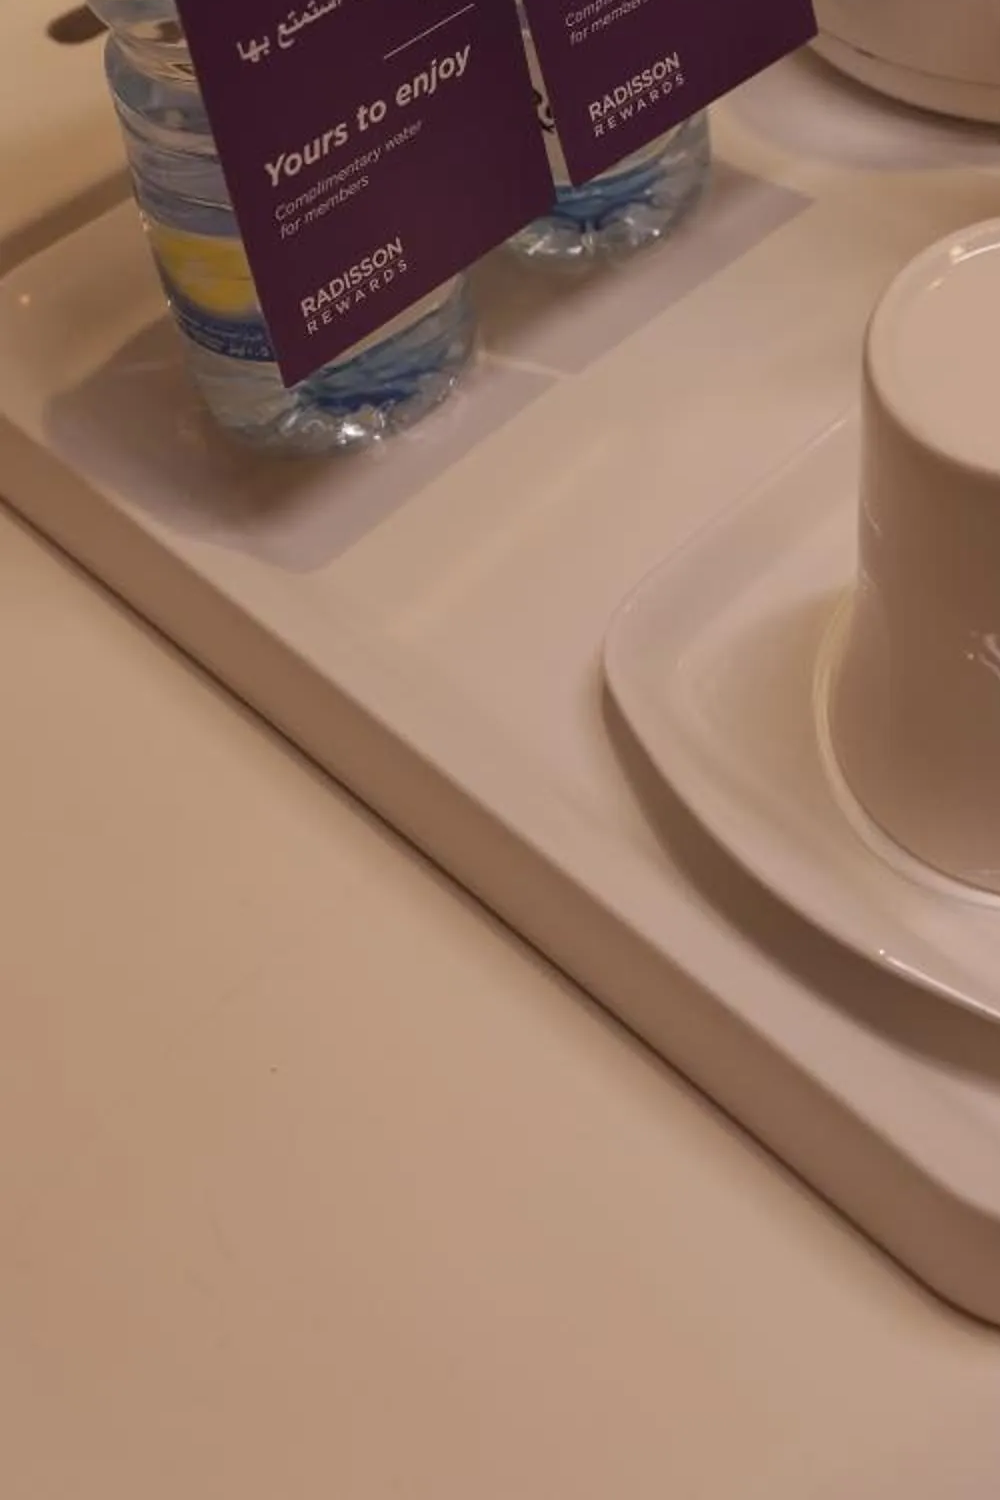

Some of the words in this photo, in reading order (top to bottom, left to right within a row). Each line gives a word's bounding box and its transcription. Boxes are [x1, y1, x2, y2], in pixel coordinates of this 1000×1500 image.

[236, 35, 271, 63] بها
[568, 25, 589, 46] for
[265, 121, 349, 187] Yours
[356, 99, 387, 130] to
[395, 44, 471, 105] enjoy
[588, 51, 681, 121] RADISSON
[594, 73, 685, 137] REWARDS
[274, 146, 382, 222] Complimentary
[384, 120, 423, 151] water
[279, 215, 302, 239] for
[303, 176, 370, 223] members
[300, 237, 404, 318] RADISSON
[307, 259, 408, 335] REWARDS
